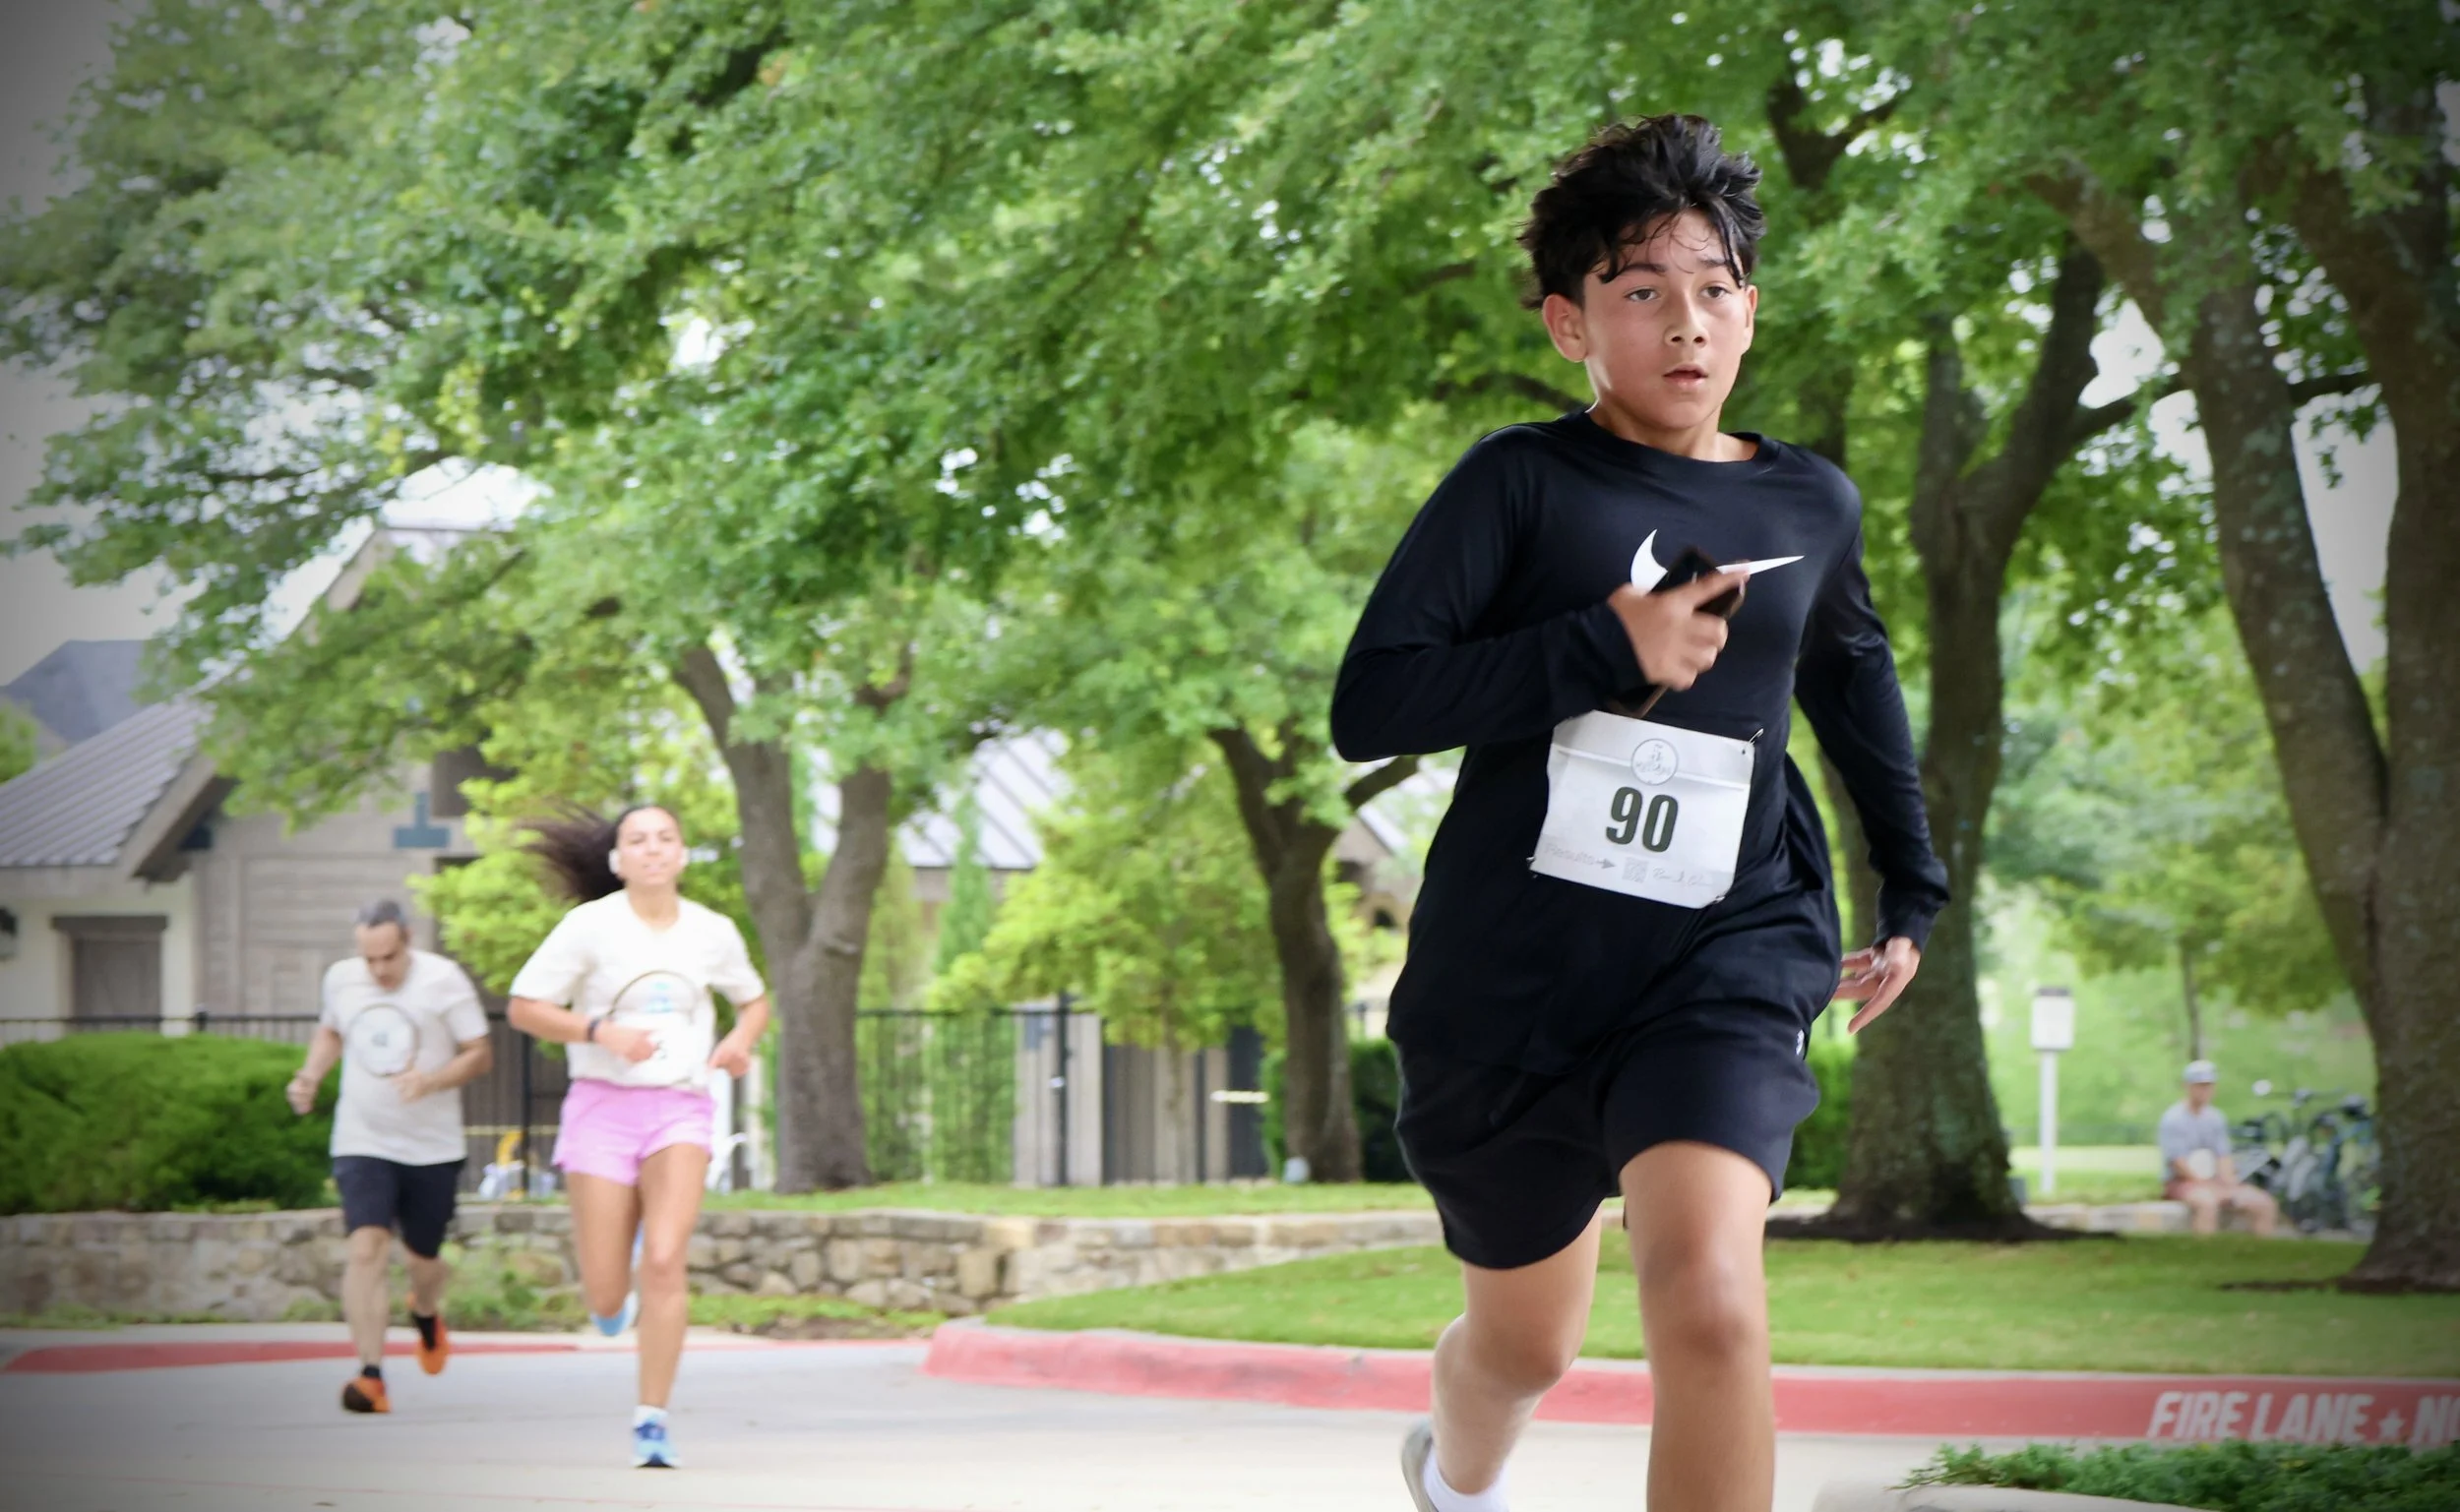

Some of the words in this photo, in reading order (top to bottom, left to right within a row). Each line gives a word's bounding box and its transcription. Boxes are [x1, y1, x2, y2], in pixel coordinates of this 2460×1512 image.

[1605, 786, 1679, 853] 90
[2146, 1390, 2249, 1439] FIRE
[2249, 1392, 2375, 1443] LANE
